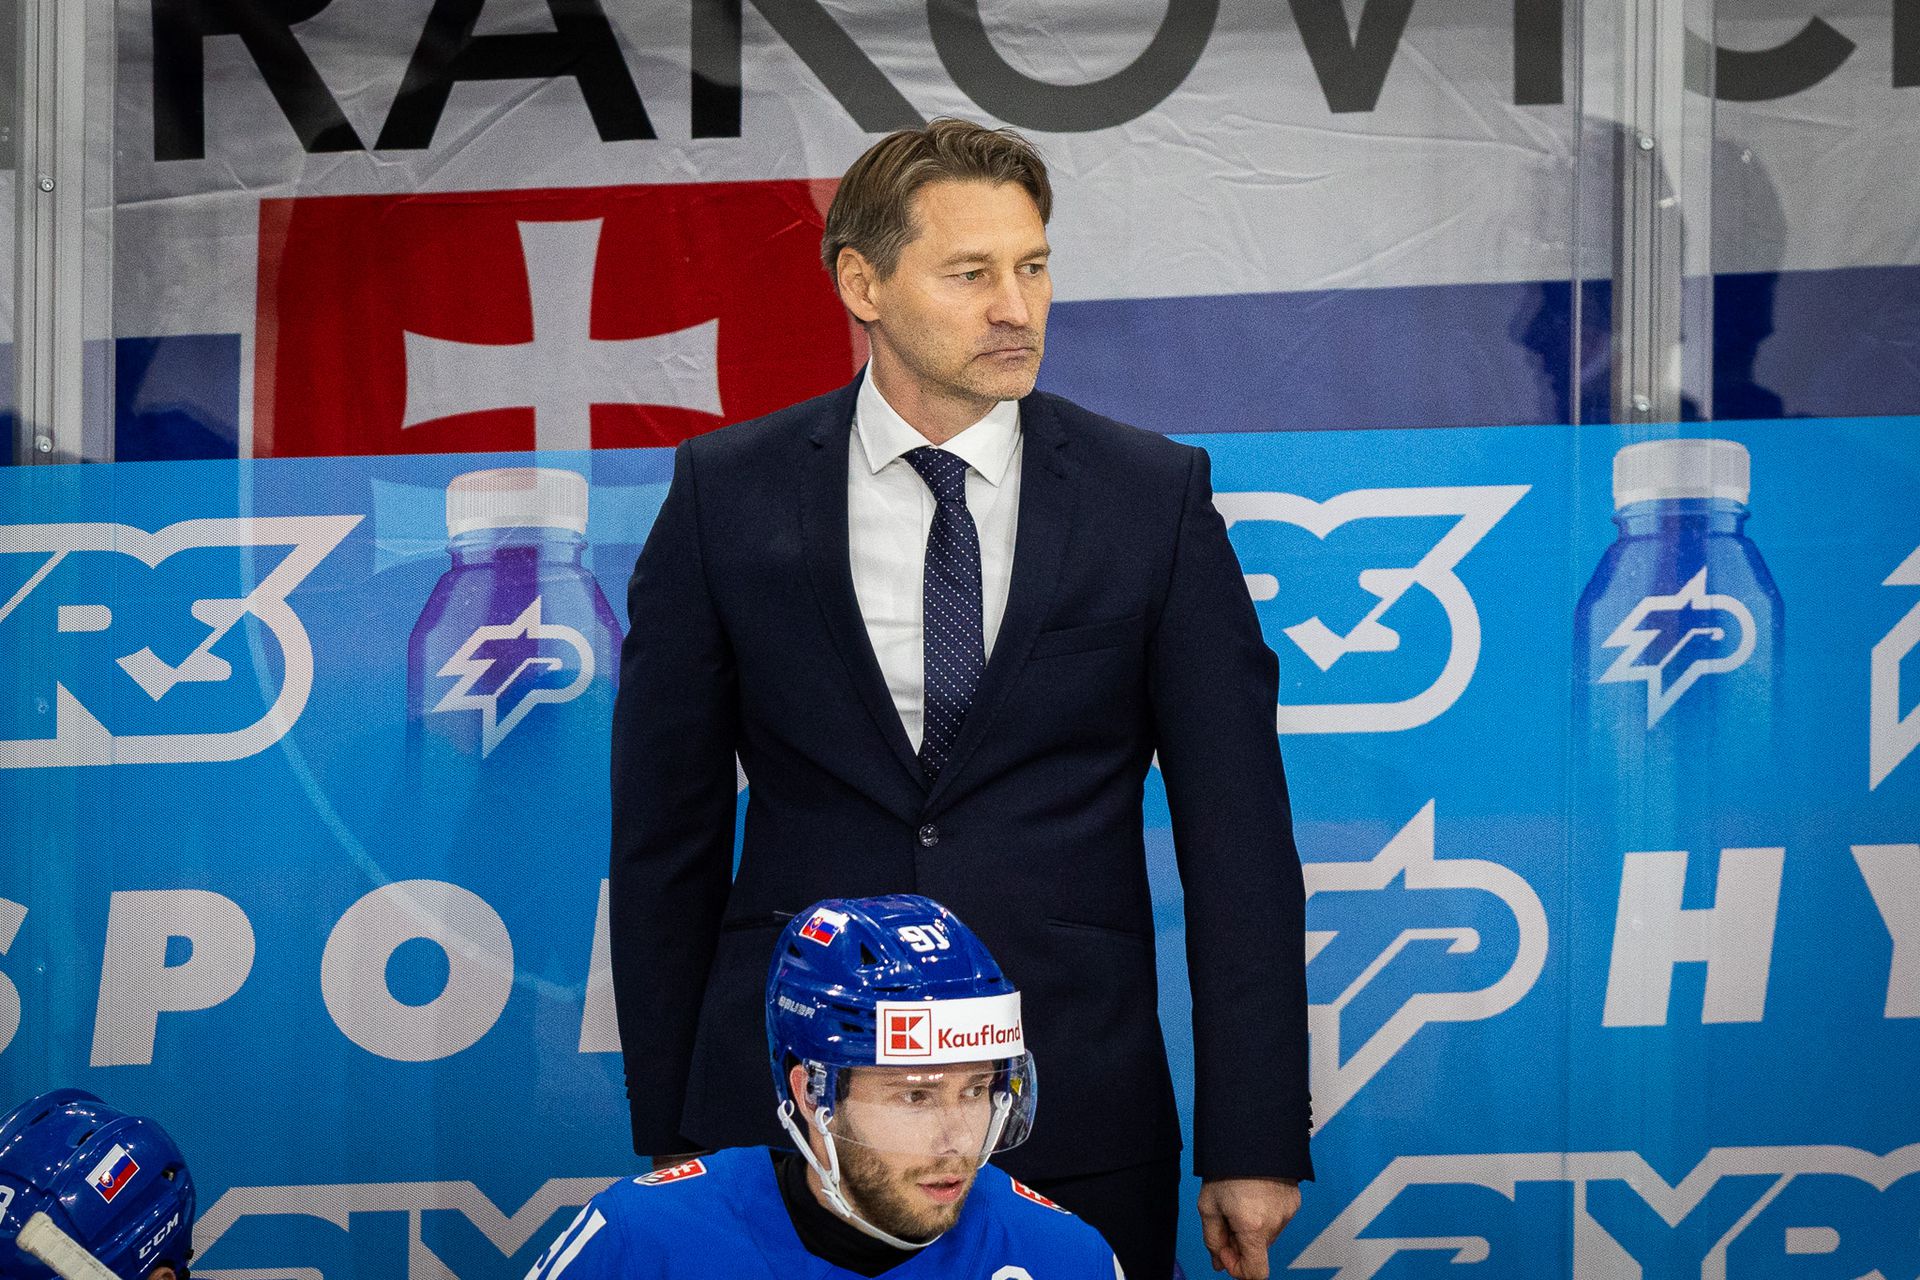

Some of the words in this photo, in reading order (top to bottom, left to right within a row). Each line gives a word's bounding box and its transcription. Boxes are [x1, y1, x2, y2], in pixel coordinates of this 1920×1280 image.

[153, 0, 1920, 162] RAKOVIC
[896, 924, 951, 952] 91
[937, 1019, 1022, 1050] Kaufland
[139, 1212, 179, 1259] CCM
